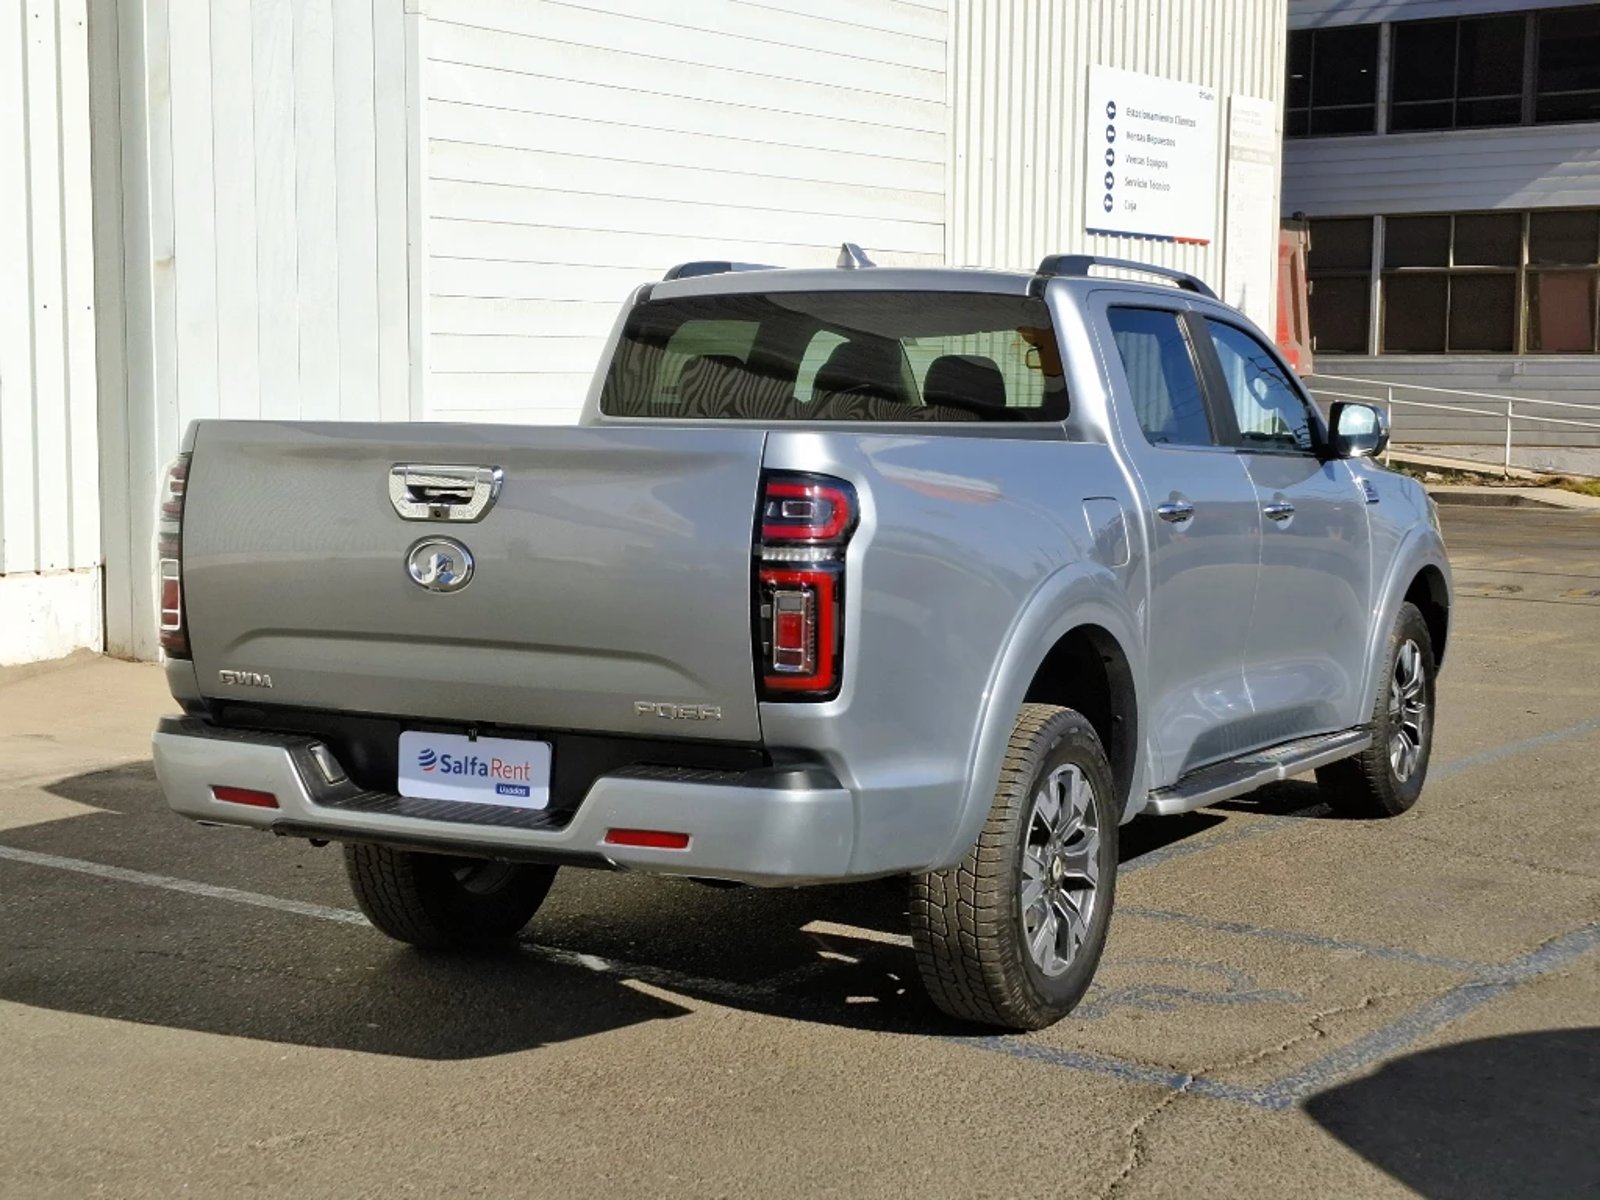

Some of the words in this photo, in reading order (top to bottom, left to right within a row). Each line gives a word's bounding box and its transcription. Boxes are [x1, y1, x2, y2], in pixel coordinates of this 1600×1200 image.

[1126, 107, 1174, 124] Estacionamiento
[1174, 115, 1196, 128] Clientes
[1126, 131, 1146, 143] Ventas
[1146, 134, 1176, 148] Repuestos
[1146, 156, 1168, 170] Equipos
[1124, 176, 1147, 189] Servicio
[1124, 199, 1137, 213] Caja
[219, 669, 272, 688] GWM
[633, 700, 721, 721] POER
[440, 754, 531, 782] SalfaRent
